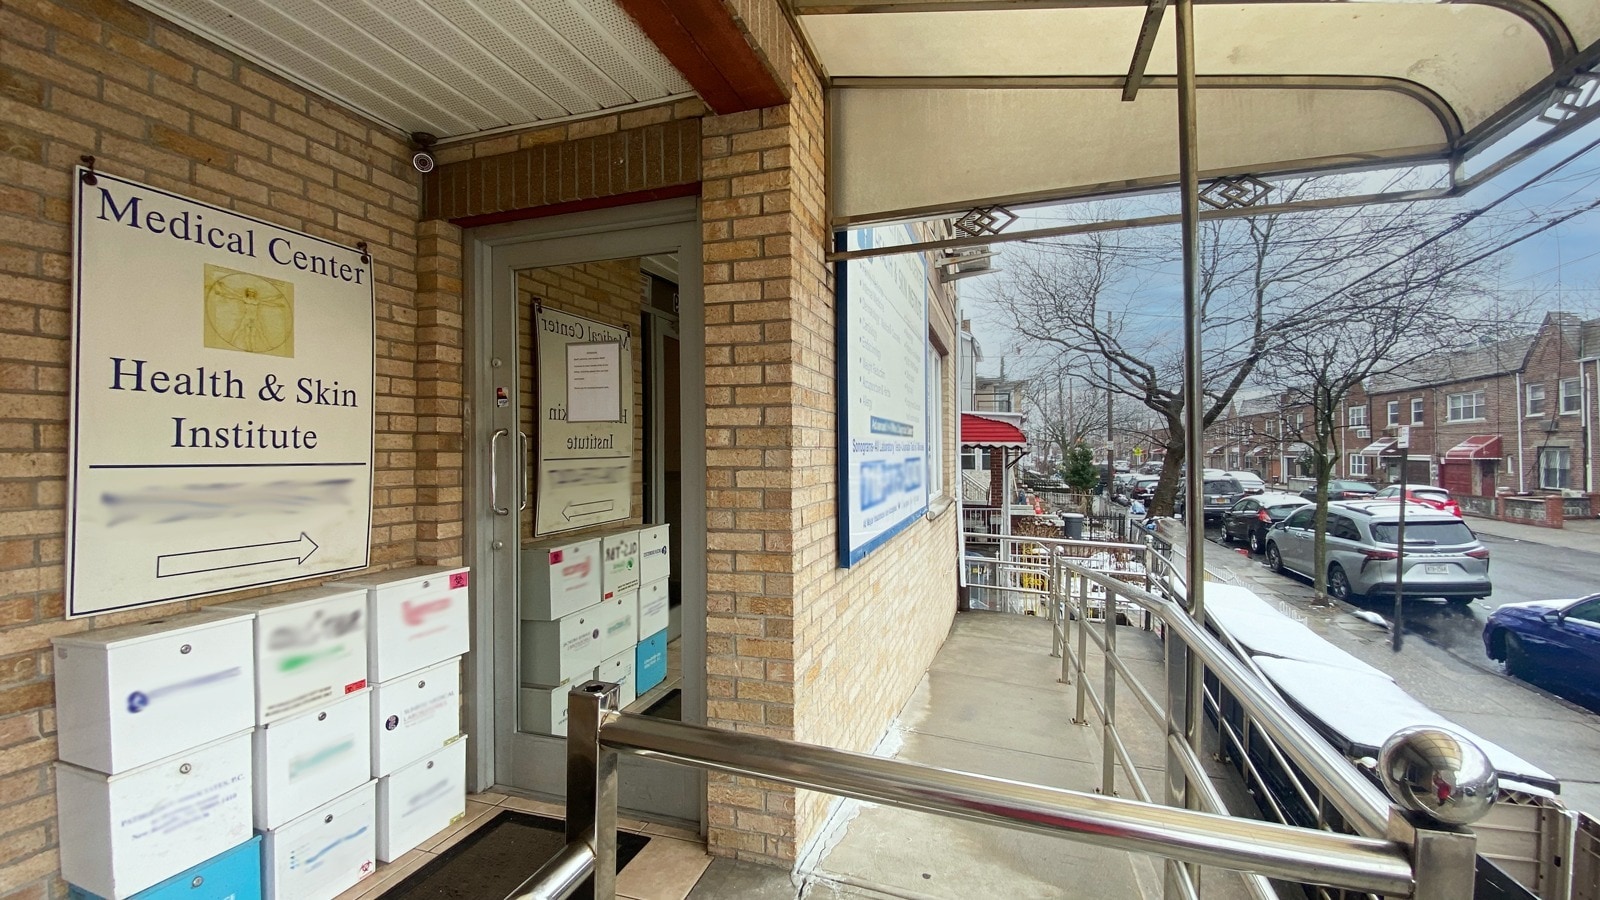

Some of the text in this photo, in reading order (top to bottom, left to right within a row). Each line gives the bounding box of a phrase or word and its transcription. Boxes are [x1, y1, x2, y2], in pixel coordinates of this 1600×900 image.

[96, 186, 365, 285] Medical Center
[108, 356, 359, 408] Health & Skin
[170, 417, 318, 450] Institute
